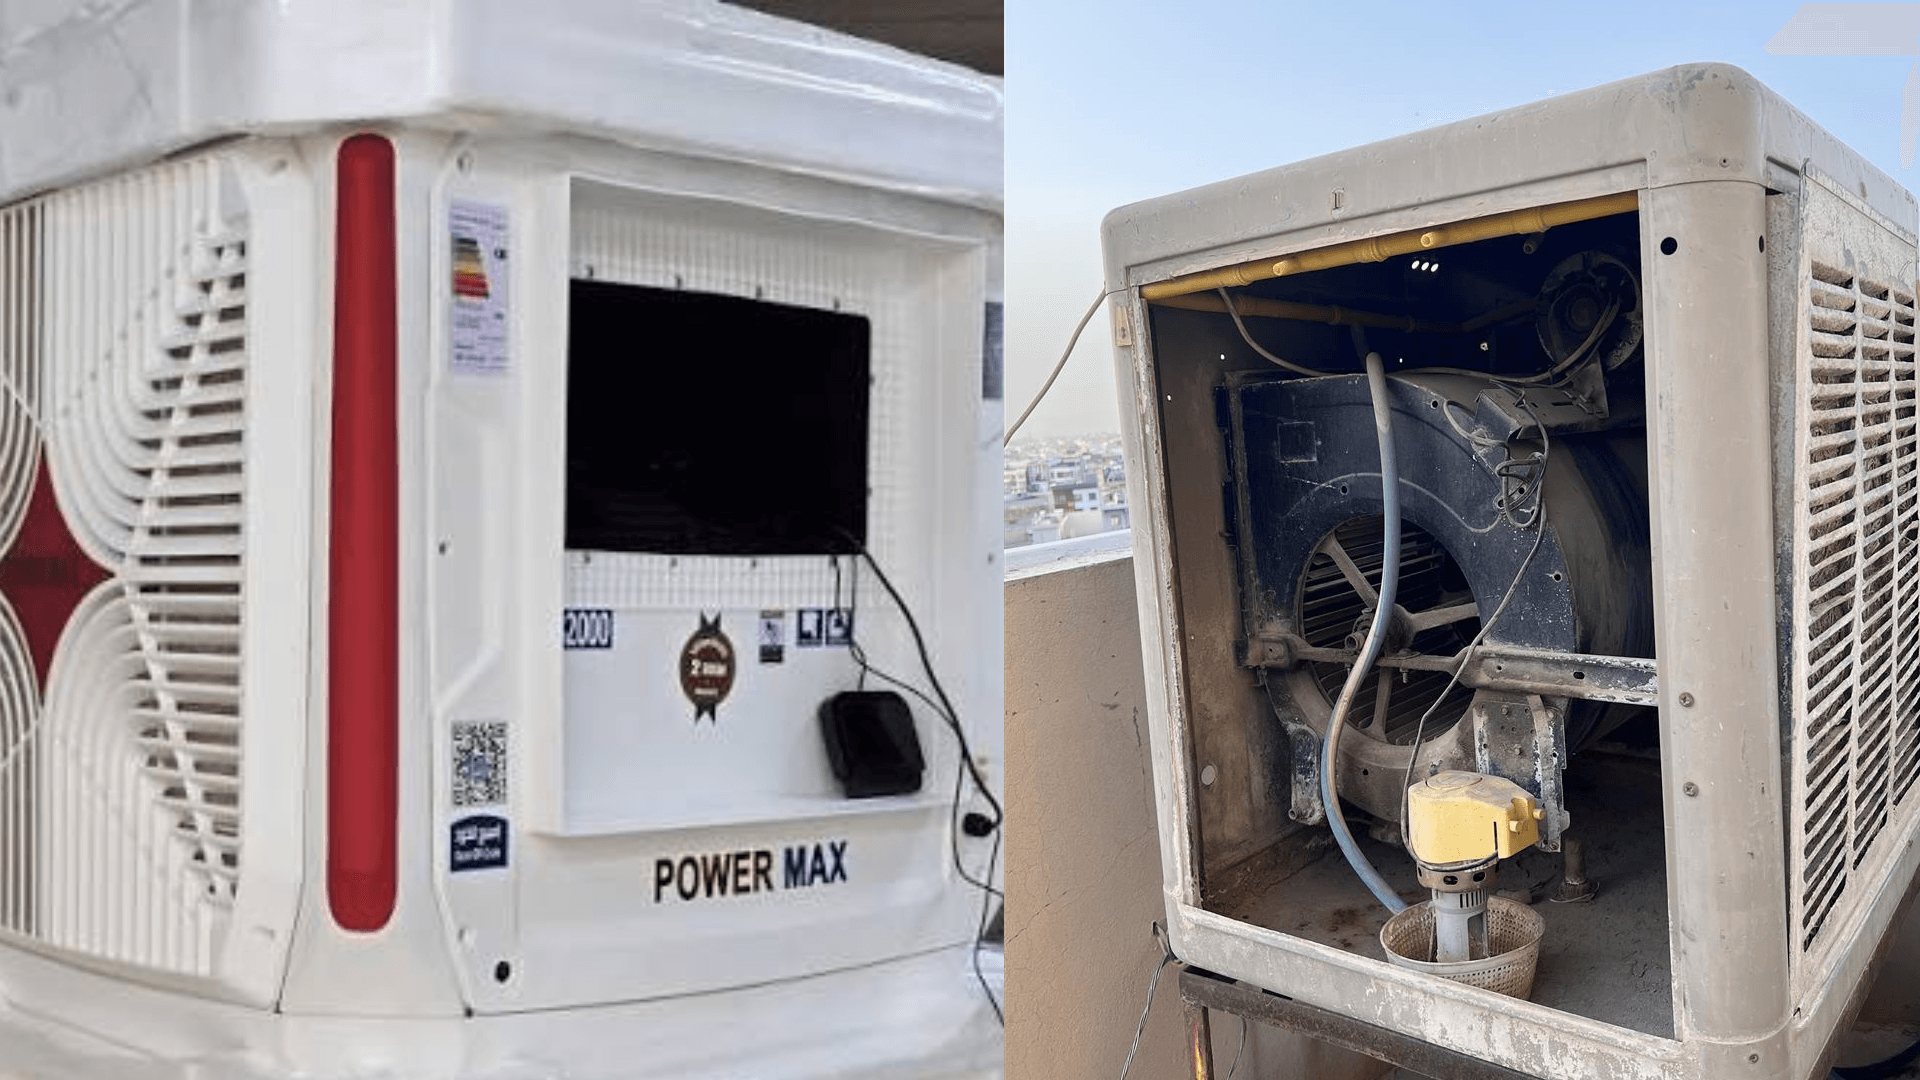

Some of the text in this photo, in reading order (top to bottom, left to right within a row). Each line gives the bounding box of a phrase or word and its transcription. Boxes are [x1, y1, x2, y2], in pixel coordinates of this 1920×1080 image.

[565, 611, 609, 646] 2000
[654, 841, 848, 903] POWER MAX
